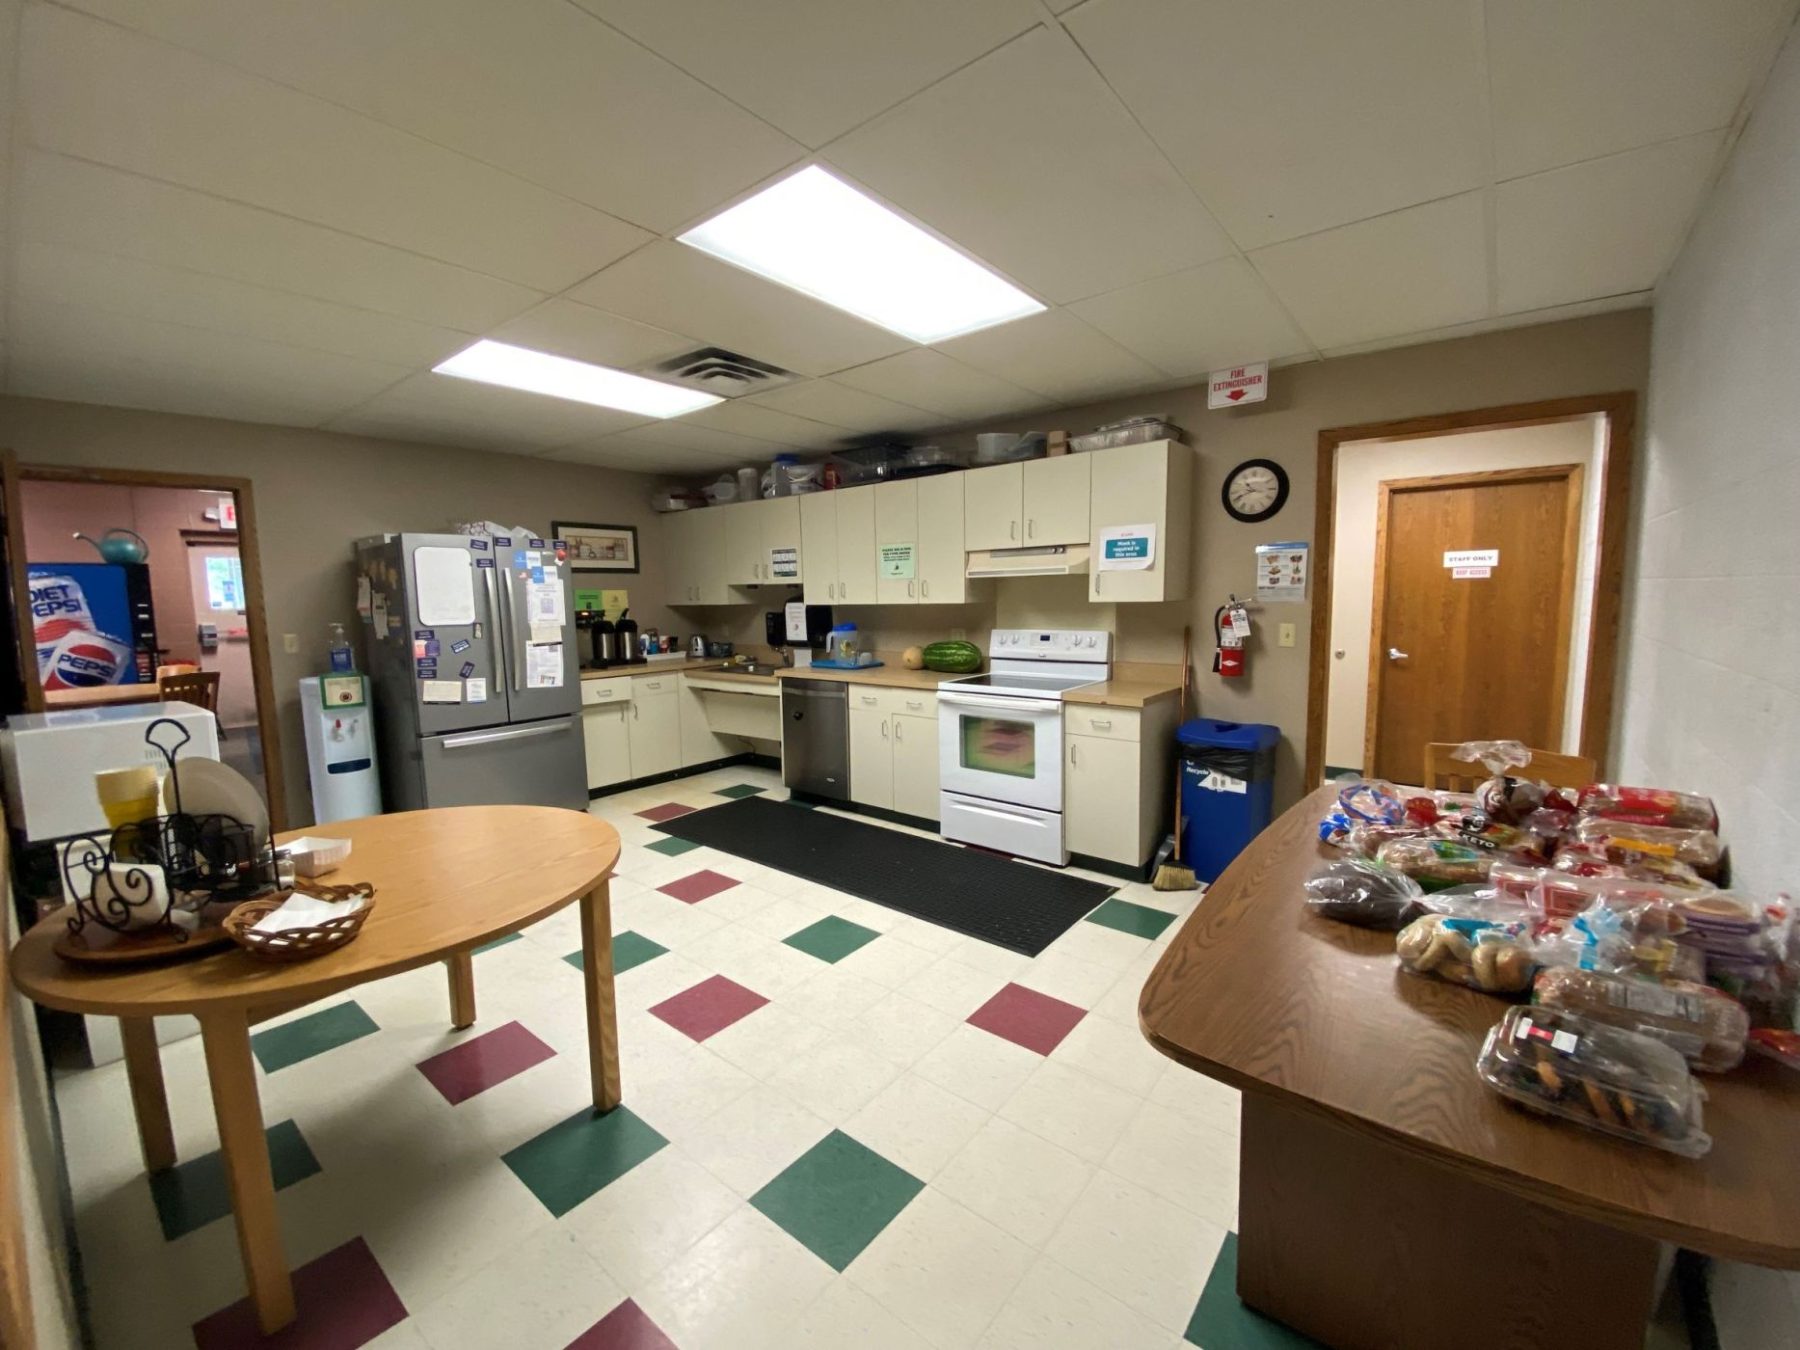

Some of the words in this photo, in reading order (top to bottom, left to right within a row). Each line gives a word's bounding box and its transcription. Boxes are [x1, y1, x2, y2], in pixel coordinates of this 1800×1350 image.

[1231, 367, 1246, 379] FIRE
[1213, 374, 1263, 392] EXTINGUISHER
[32, 599, 82, 617] EPSI
[58, 654, 117, 678] PEPSI
[1462, 834, 1495, 848] KETO
